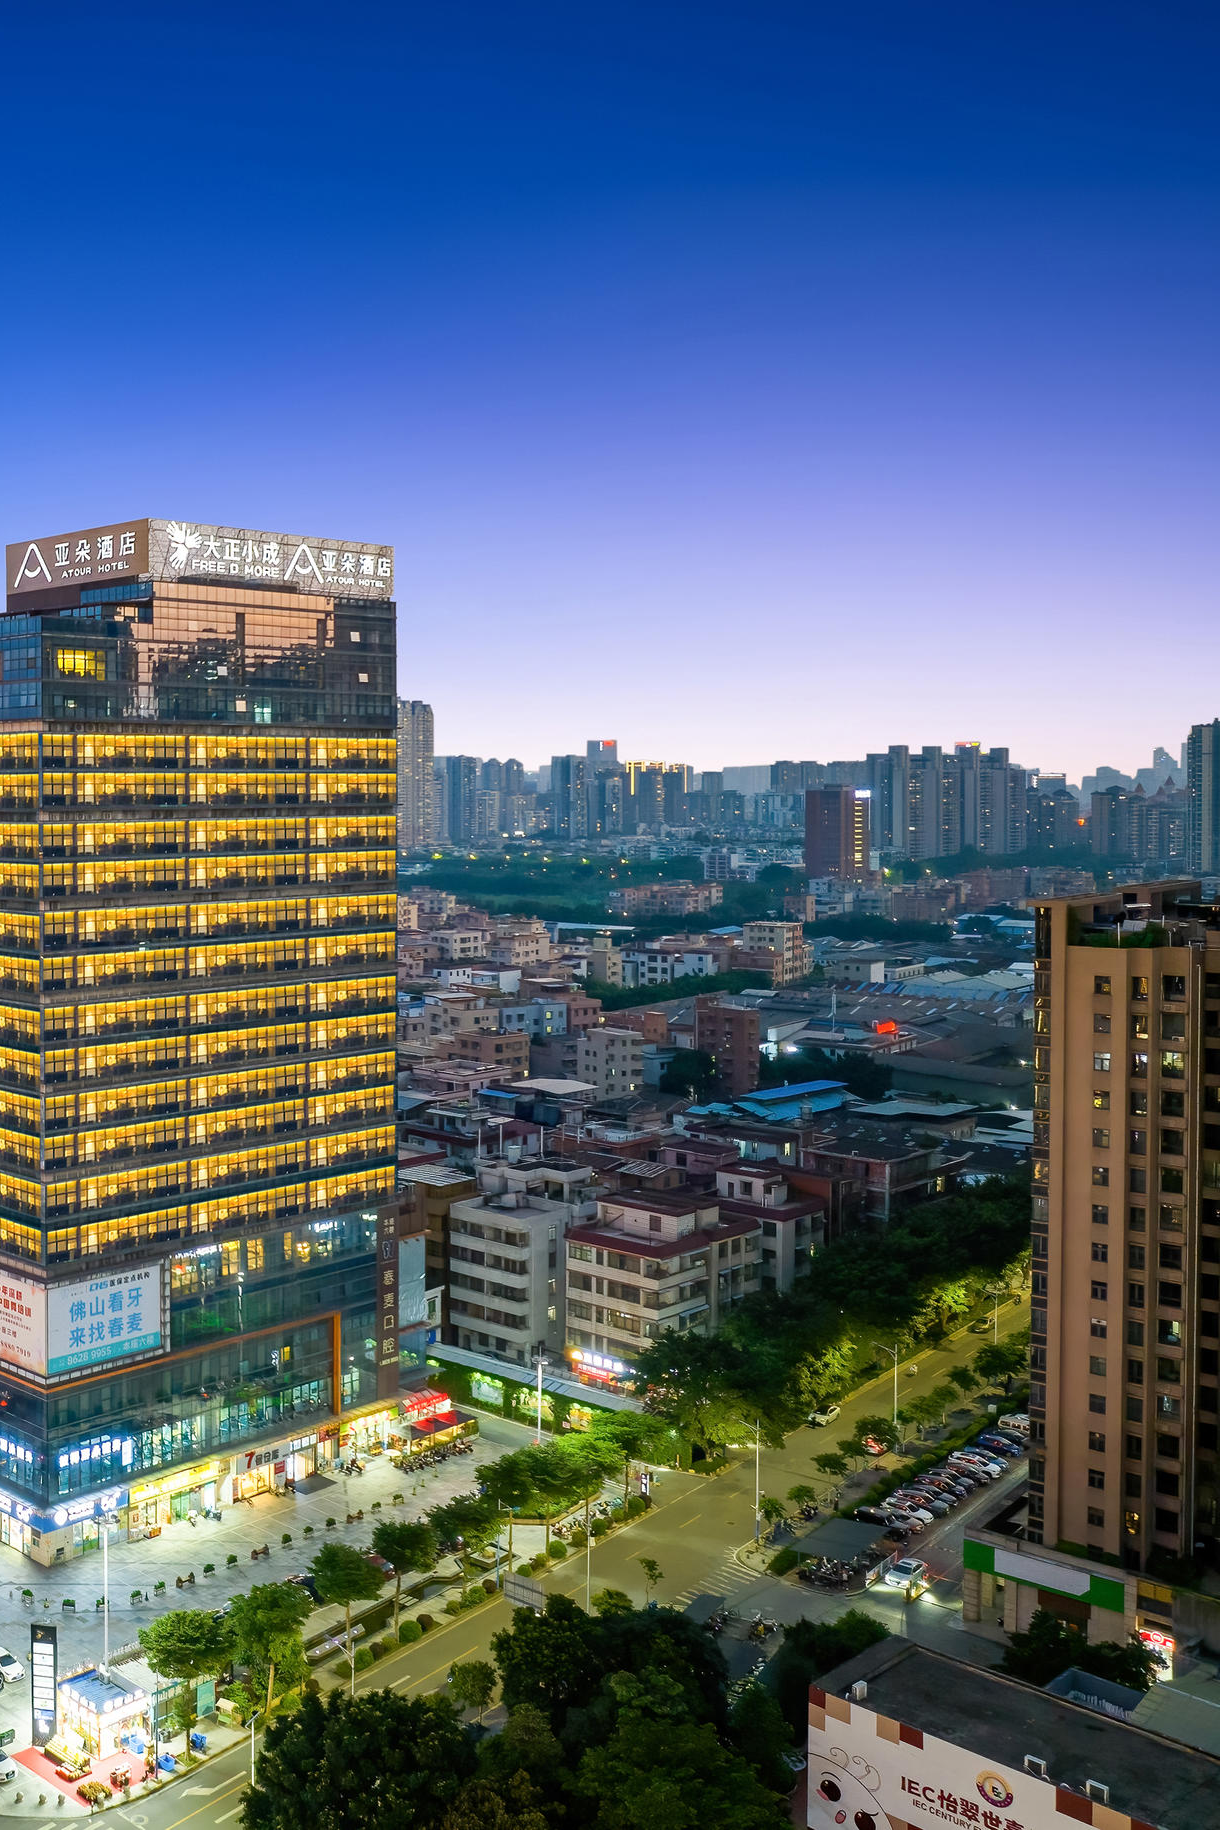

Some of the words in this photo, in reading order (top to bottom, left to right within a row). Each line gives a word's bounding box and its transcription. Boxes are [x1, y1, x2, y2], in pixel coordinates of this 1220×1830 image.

[54, 532, 136, 567] 亚朵酒店
[203, 535, 280, 566] 大正小成
[321, 550, 391, 577] 亚朵酒店
[61, 566, 92, 579] ATOUR
[98, 560, 130, 573] HOTEL
[244, 565, 280, 578] MORE
[326, 576, 355, 585] ATOUR
[359, 579, 386, 588] HOTEL
[69, 1286, 143, 1323] 佛山看牙
[912, 1798, 928, 1811] IEC
[929, 1806, 972, 1830] CENTURY
